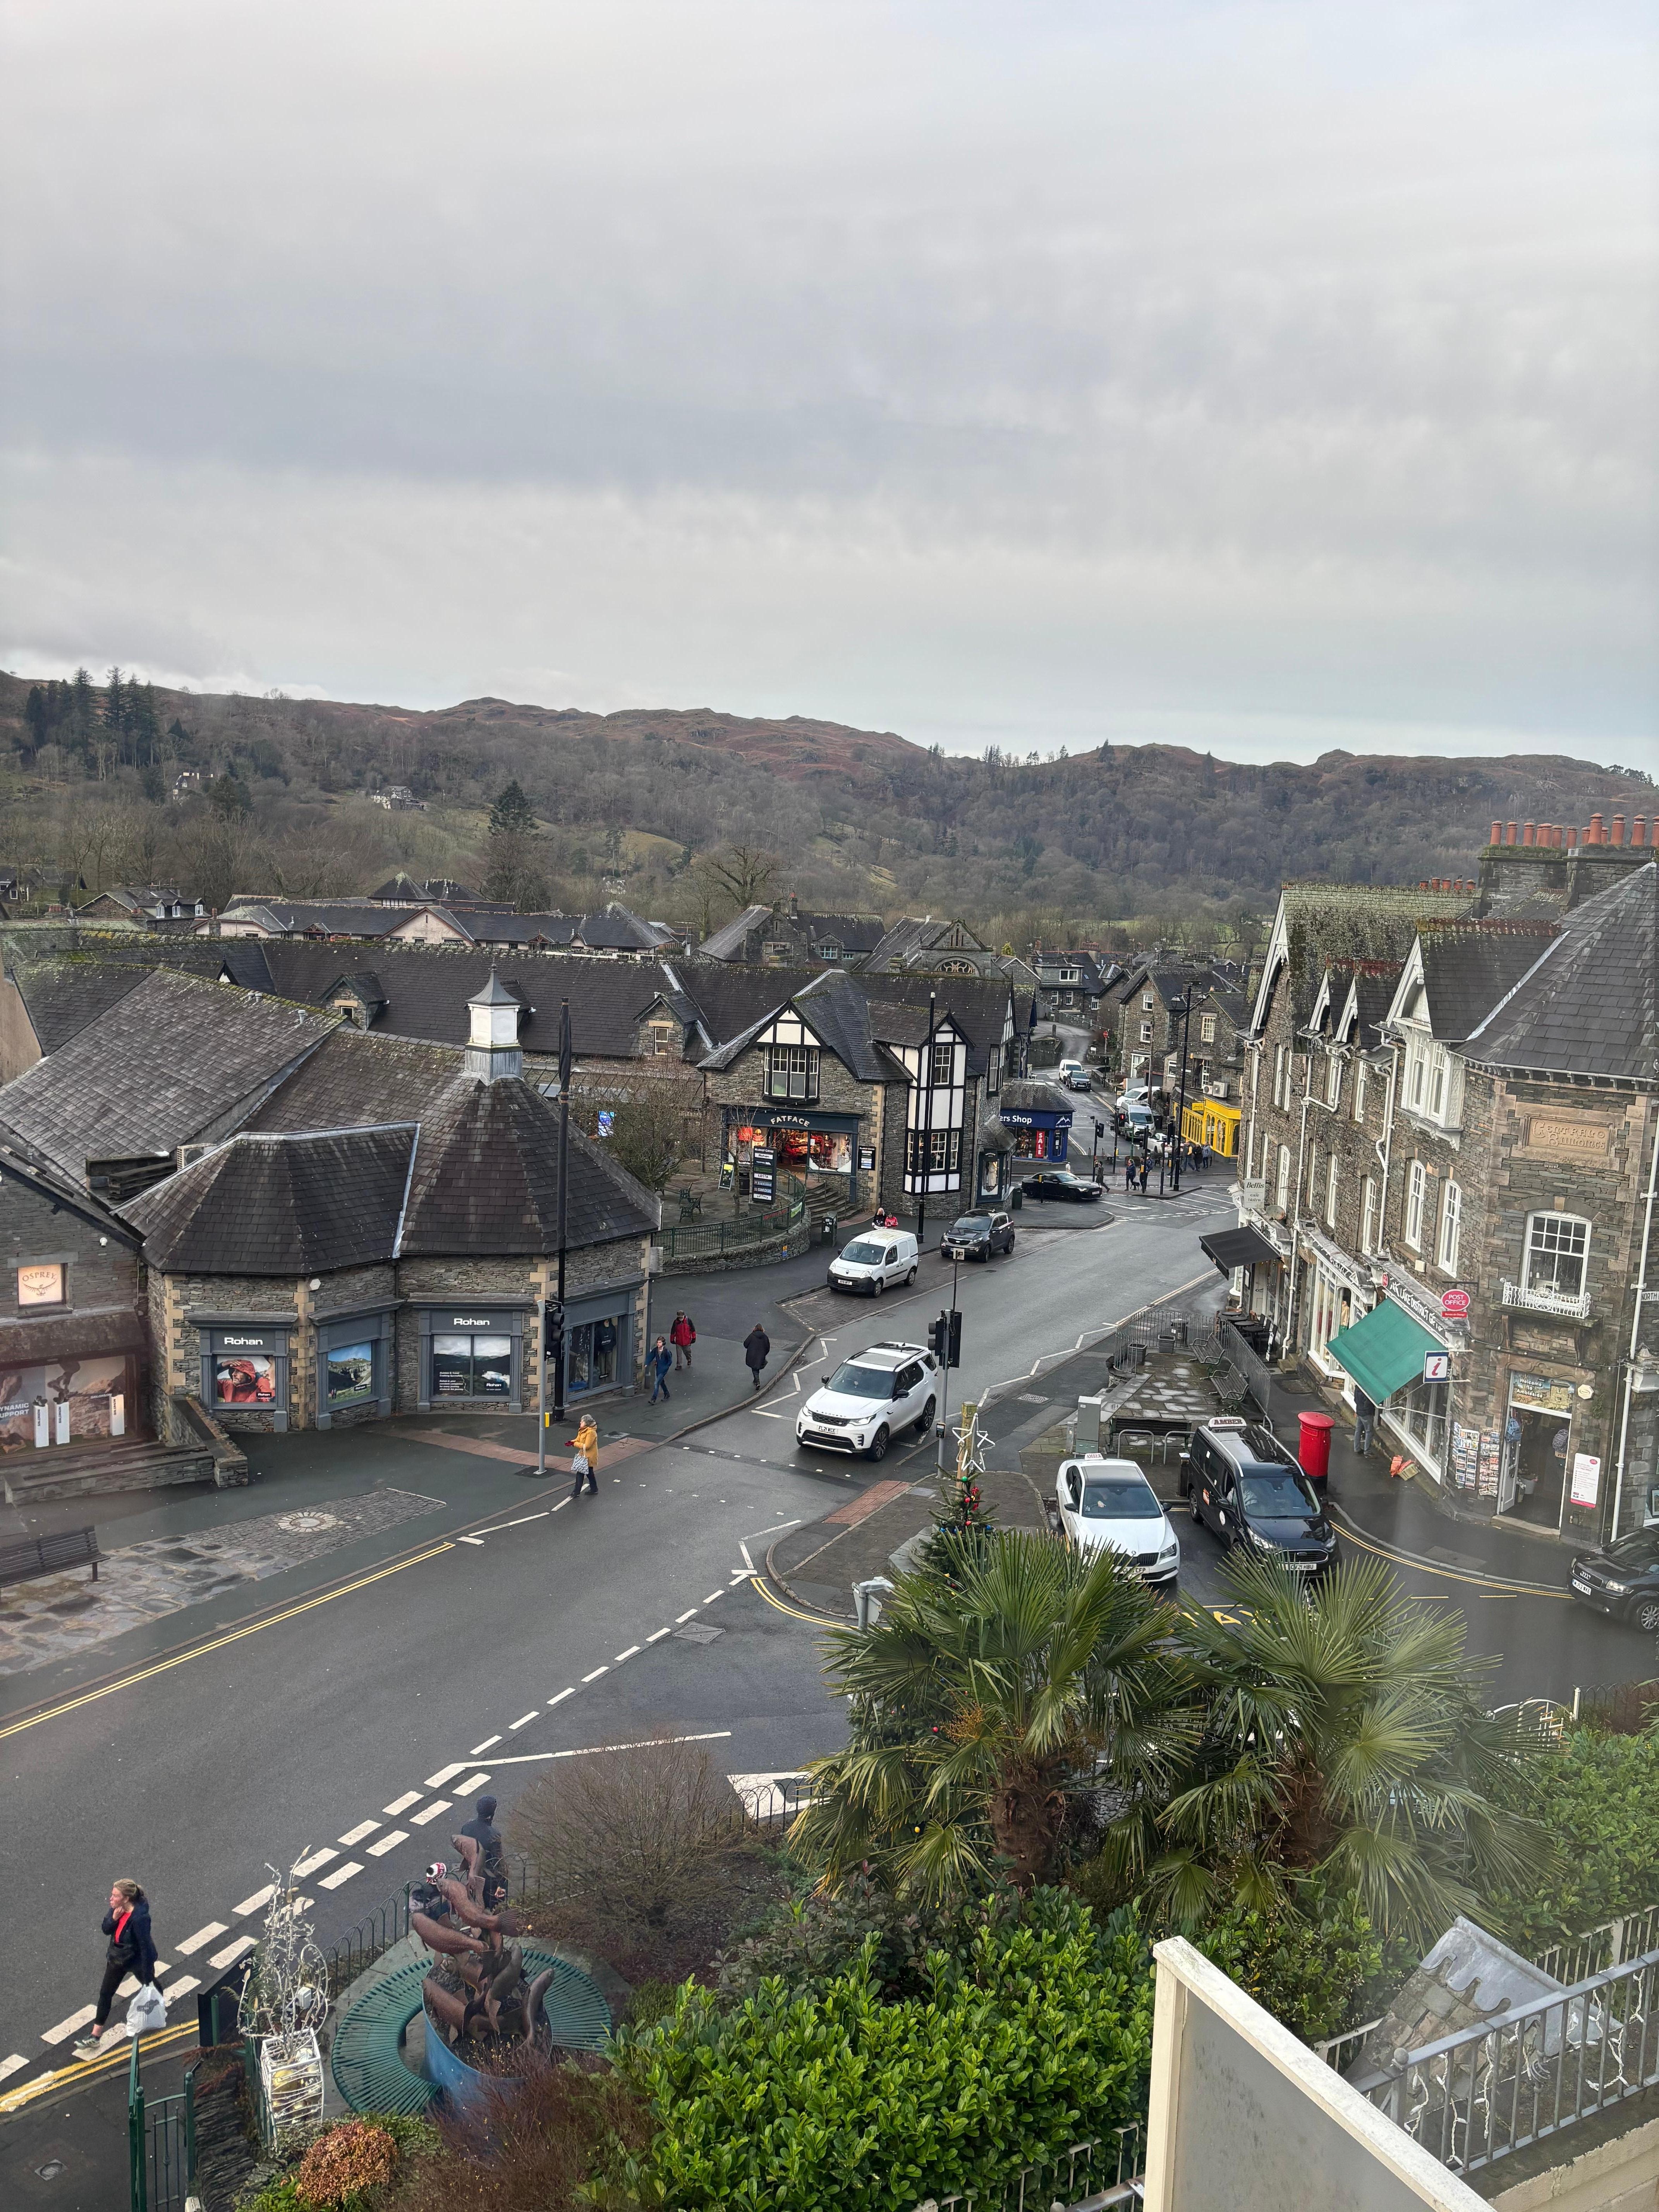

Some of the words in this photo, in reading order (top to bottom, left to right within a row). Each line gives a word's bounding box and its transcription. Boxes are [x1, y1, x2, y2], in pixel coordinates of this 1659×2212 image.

[770, 1115, 810, 1127] FATFACE
[1012, 1115, 1032, 1125] Shop
[22, 1271, 57, 1281] OSPREY
[1400, 1288, 1411, 1305] LAKE
[1411, 1297, 1429, 1320] DISTRICT
[1520, 1378, 1542, 1387] Welcome
[1516, 1389, 1543, 1398] Ambleside
[0, 1403, 29, 1412] YNAMIC
[0, 1409, 29, 1418] UPPORT
